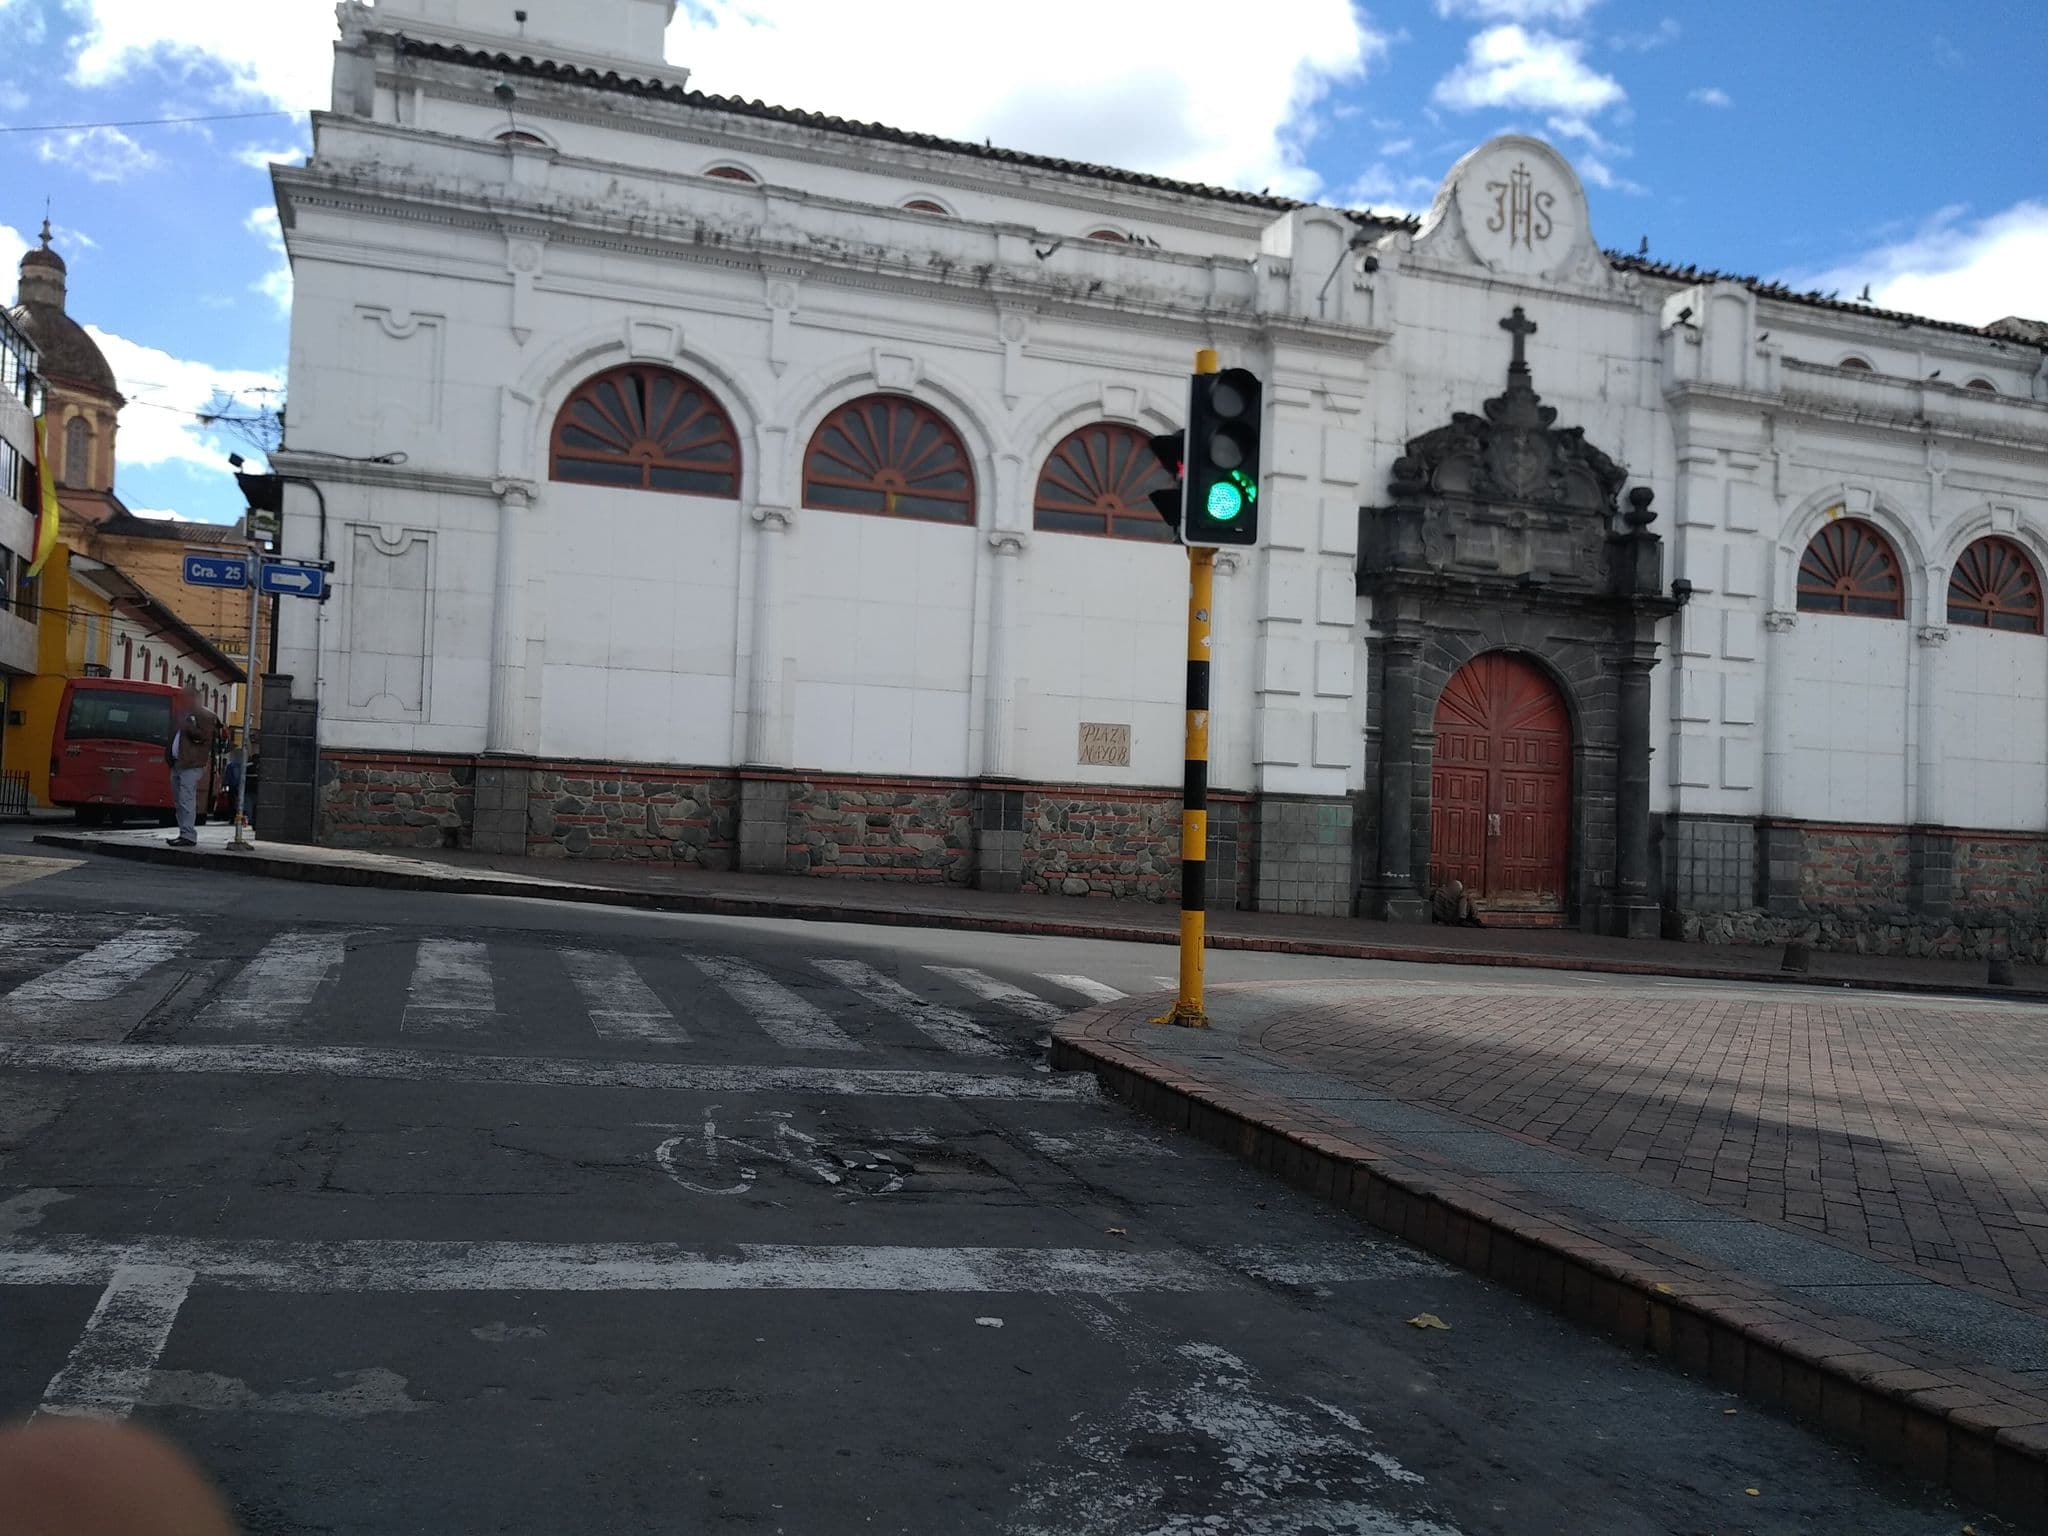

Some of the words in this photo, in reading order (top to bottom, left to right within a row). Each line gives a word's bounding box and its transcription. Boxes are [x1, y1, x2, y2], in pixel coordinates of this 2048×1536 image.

[191, 563, 217, 578] Cra.
[225, 567, 241, 580] 25
[1080, 745, 1129, 765] MAYOR
